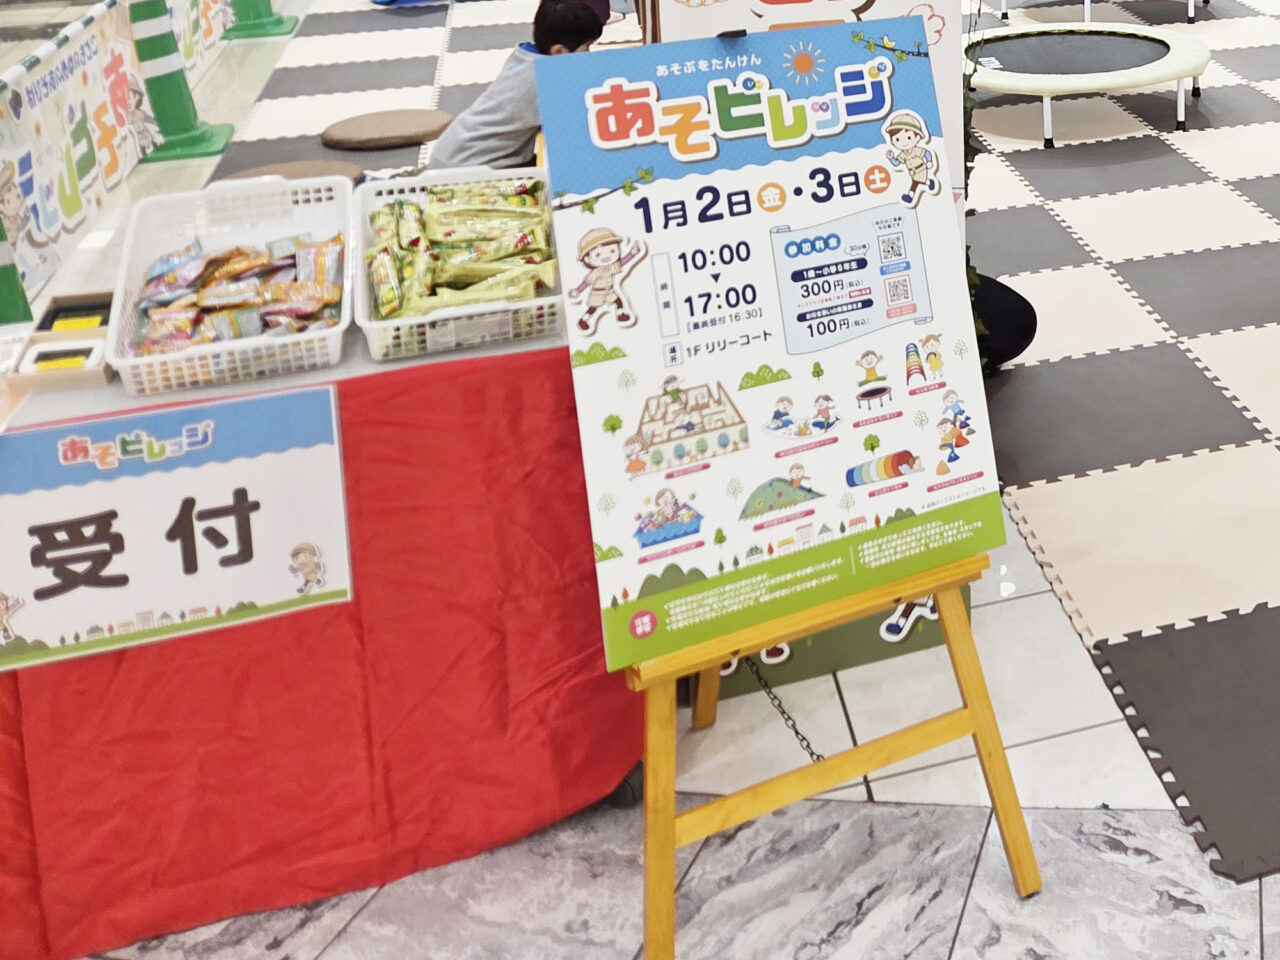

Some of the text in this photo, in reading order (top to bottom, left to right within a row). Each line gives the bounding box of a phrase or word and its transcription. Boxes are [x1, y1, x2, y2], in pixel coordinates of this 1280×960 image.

[655, 53, 762, 78] あそぶをたんけん
[592, 61, 888, 152] あそビレッジ
[677, 241, 751, 274] 10:00
[683, 284, 758, 318] 17:00
[58, 421, 215, 470] あそビレッジ
[28, 487, 260, 602] 受付
